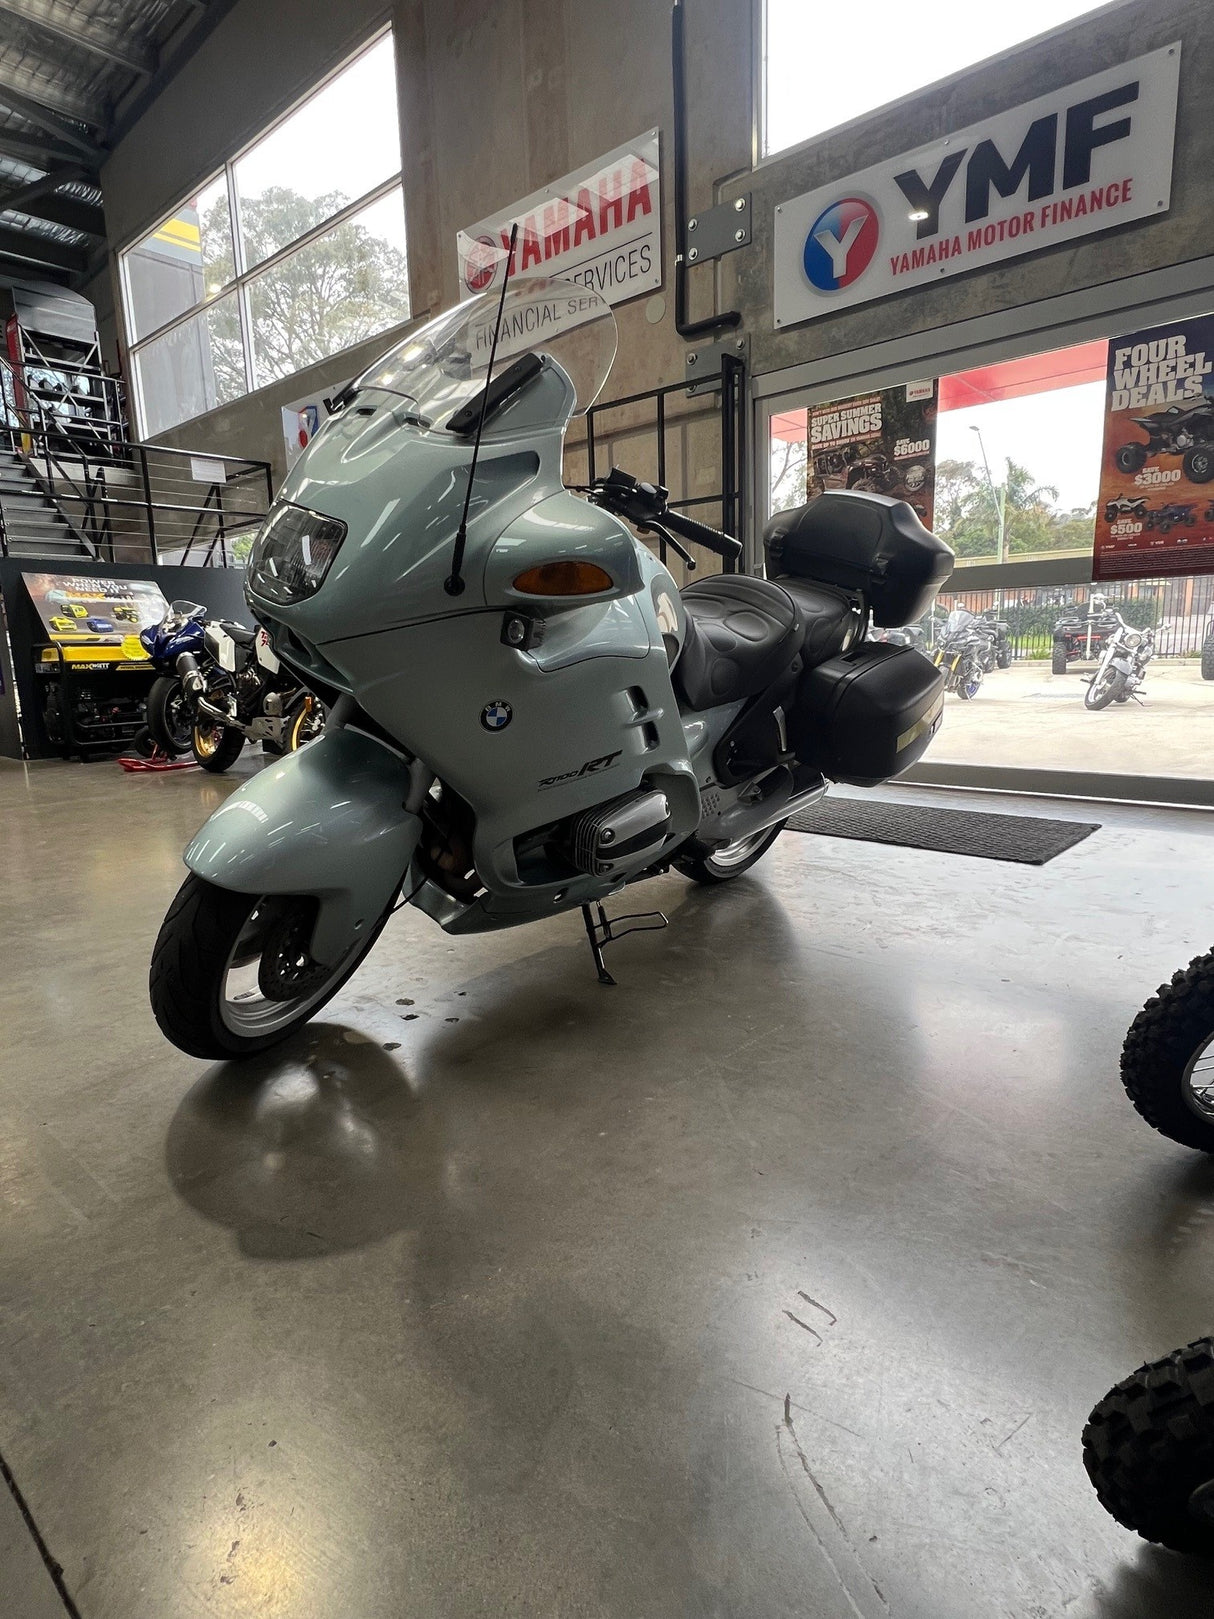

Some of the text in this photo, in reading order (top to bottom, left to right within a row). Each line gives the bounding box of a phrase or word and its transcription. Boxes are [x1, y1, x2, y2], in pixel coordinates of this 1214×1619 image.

[894, 81, 1140, 241] YMF
[500, 158, 652, 277] YAMAHA
[890, 178, 1133, 276] YAMAHA MOTOR FINANCE
[566, 244, 652, 290] RVICES
[475, 304, 561, 350] FINANCIAL
[1114, 334, 1187, 370] FOUR
[1113, 351, 1213, 390] WHEEL
[1111, 375, 1203, 412] DEALS
[810, 412, 883, 444] SAVINGS
[811, 412, 840, 428] SUPER
[840, 402, 882, 421] SUMMER
[893, 439, 930, 457] $6000
[1134, 469, 1182, 486] $3000
[1110, 522, 1143, 535] $500
[62, 581, 101, 589] WHEN
[72, 578, 116, 586] POWER
[71, 662, 111, 670] MAXWATT
[485, 701, 510, 712] BMW
